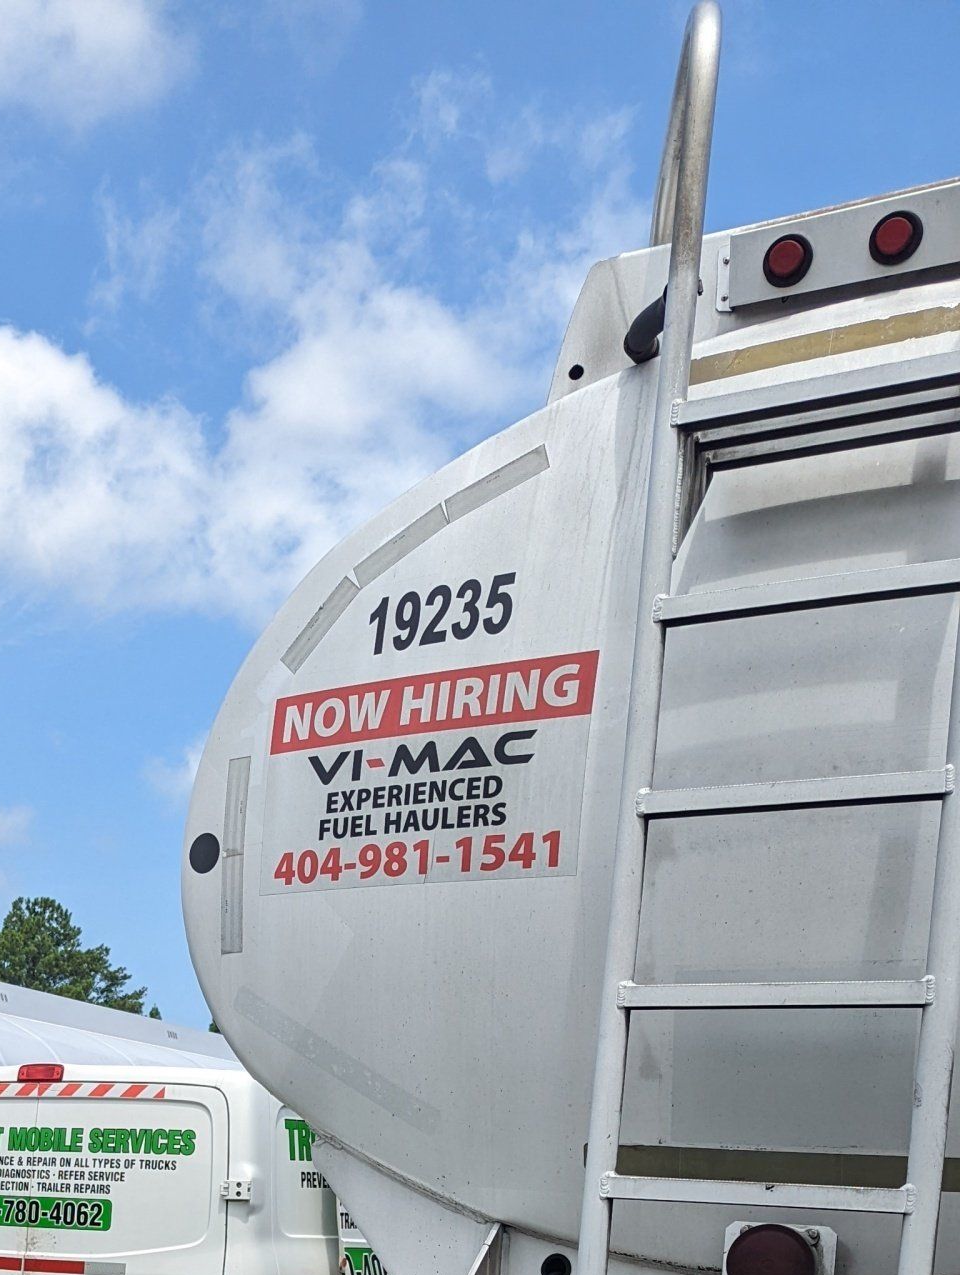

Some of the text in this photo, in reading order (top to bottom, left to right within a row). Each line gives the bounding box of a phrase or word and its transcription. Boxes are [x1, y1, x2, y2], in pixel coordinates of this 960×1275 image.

[368, 571, 517, 656] 19235
[282, 663, 581, 744] NOW HIRING
[308, 729, 538, 785] VI-MAC
[325, 774, 504, 814] EXPERIENCED
[318, 801, 508, 841] FUEL HAULERS
[273, 829, 562, 886] 404-981-1541
[8, 1127, 84, 1153] MOBILE
[88, 1128, 197, 1157] SERVICES
[285, 1118, 315, 1161] TR
[17, 1157, 24, 1166] &
[26, 1157, 57, 1168] REPAIR
[59, 1158, 71, 1168] ON
[74, 1158, 90, 1169] ALL
[92, 1159, 121, 1170] TYPES
[123, 1160, 136, 1170] OF
[139, 1160, 177, 1171] TRUCKS
[57, 1171, 86, 1181] REFER
[87, 1171, 125, 1182] SERVICE
[300, 1171, 330, 1189] PREVE
[36, 1182, 71, 1193] TRAILER
[73, 1183, 111, 1195] REPAIRS
[340, 1212, 357, 1229] TRA
